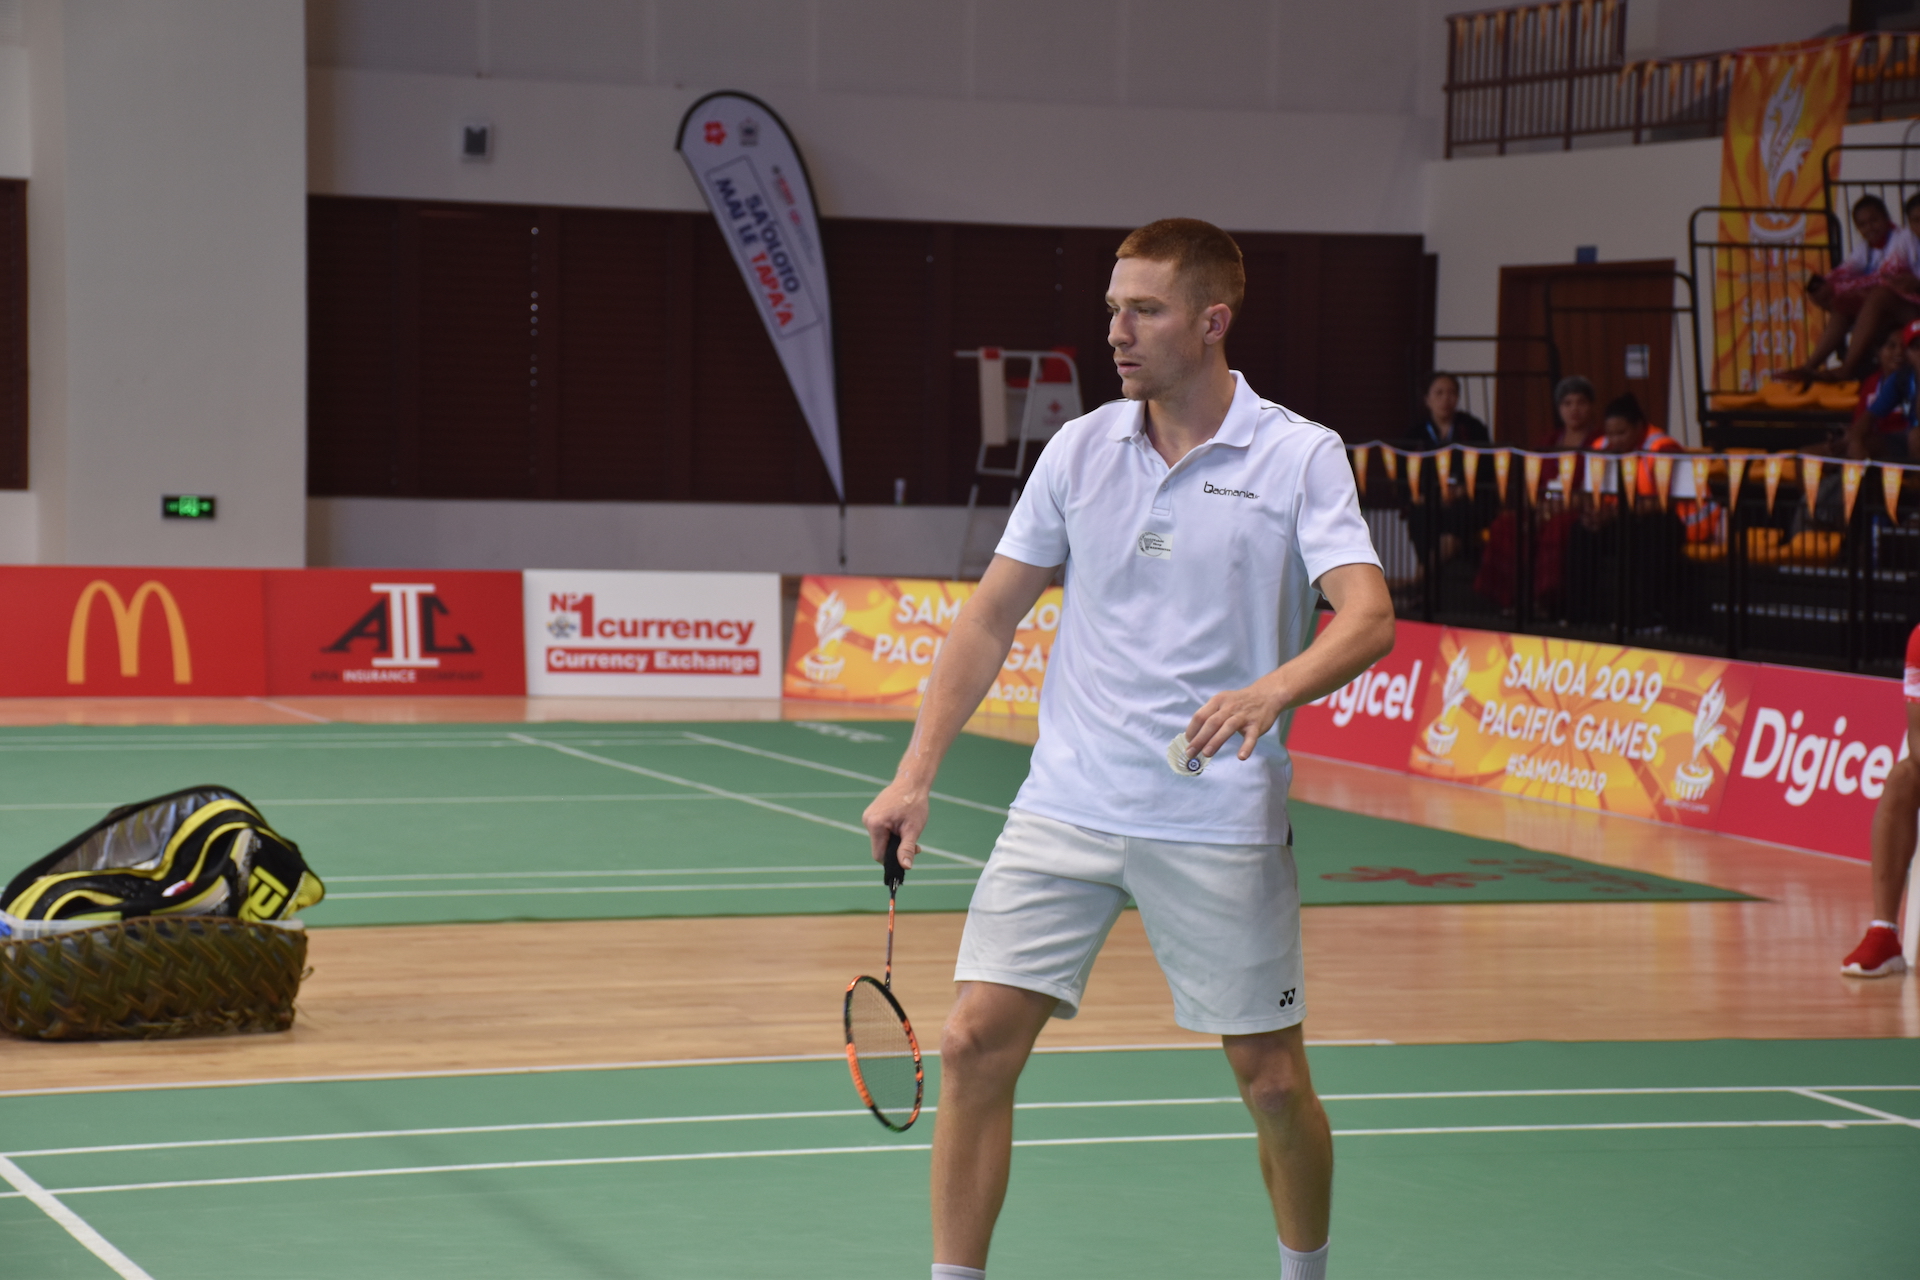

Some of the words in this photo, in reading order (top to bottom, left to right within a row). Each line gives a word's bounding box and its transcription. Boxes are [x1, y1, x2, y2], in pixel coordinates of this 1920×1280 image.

[715, 177, 747, 221] MAI
[738, 224, 758, 246] LE
[597, 618, 755, 645] currency
[896, 593, 962, 625] SAM
[1016, 603, 1061, 632] 20
[549, 649, 649, 672] Currency
[654, 651, 757, 674] Exchange
[872, 633, 943, 666] PACI
[343, 669, 417, 683] INSURANCE
[1308, 659, 1422, 728] gicel
[1503, 652, 1588, 697] SAMOA
[1591, 664, 1663, 713] 2019
[1477, 699, 1571, 746] PACIFIC
[1574, 714, 1662, 762] GAMES
[1505, 753, 1608, 796] #SAMOA2019
[1741, 707, 1910, 807] Digice
